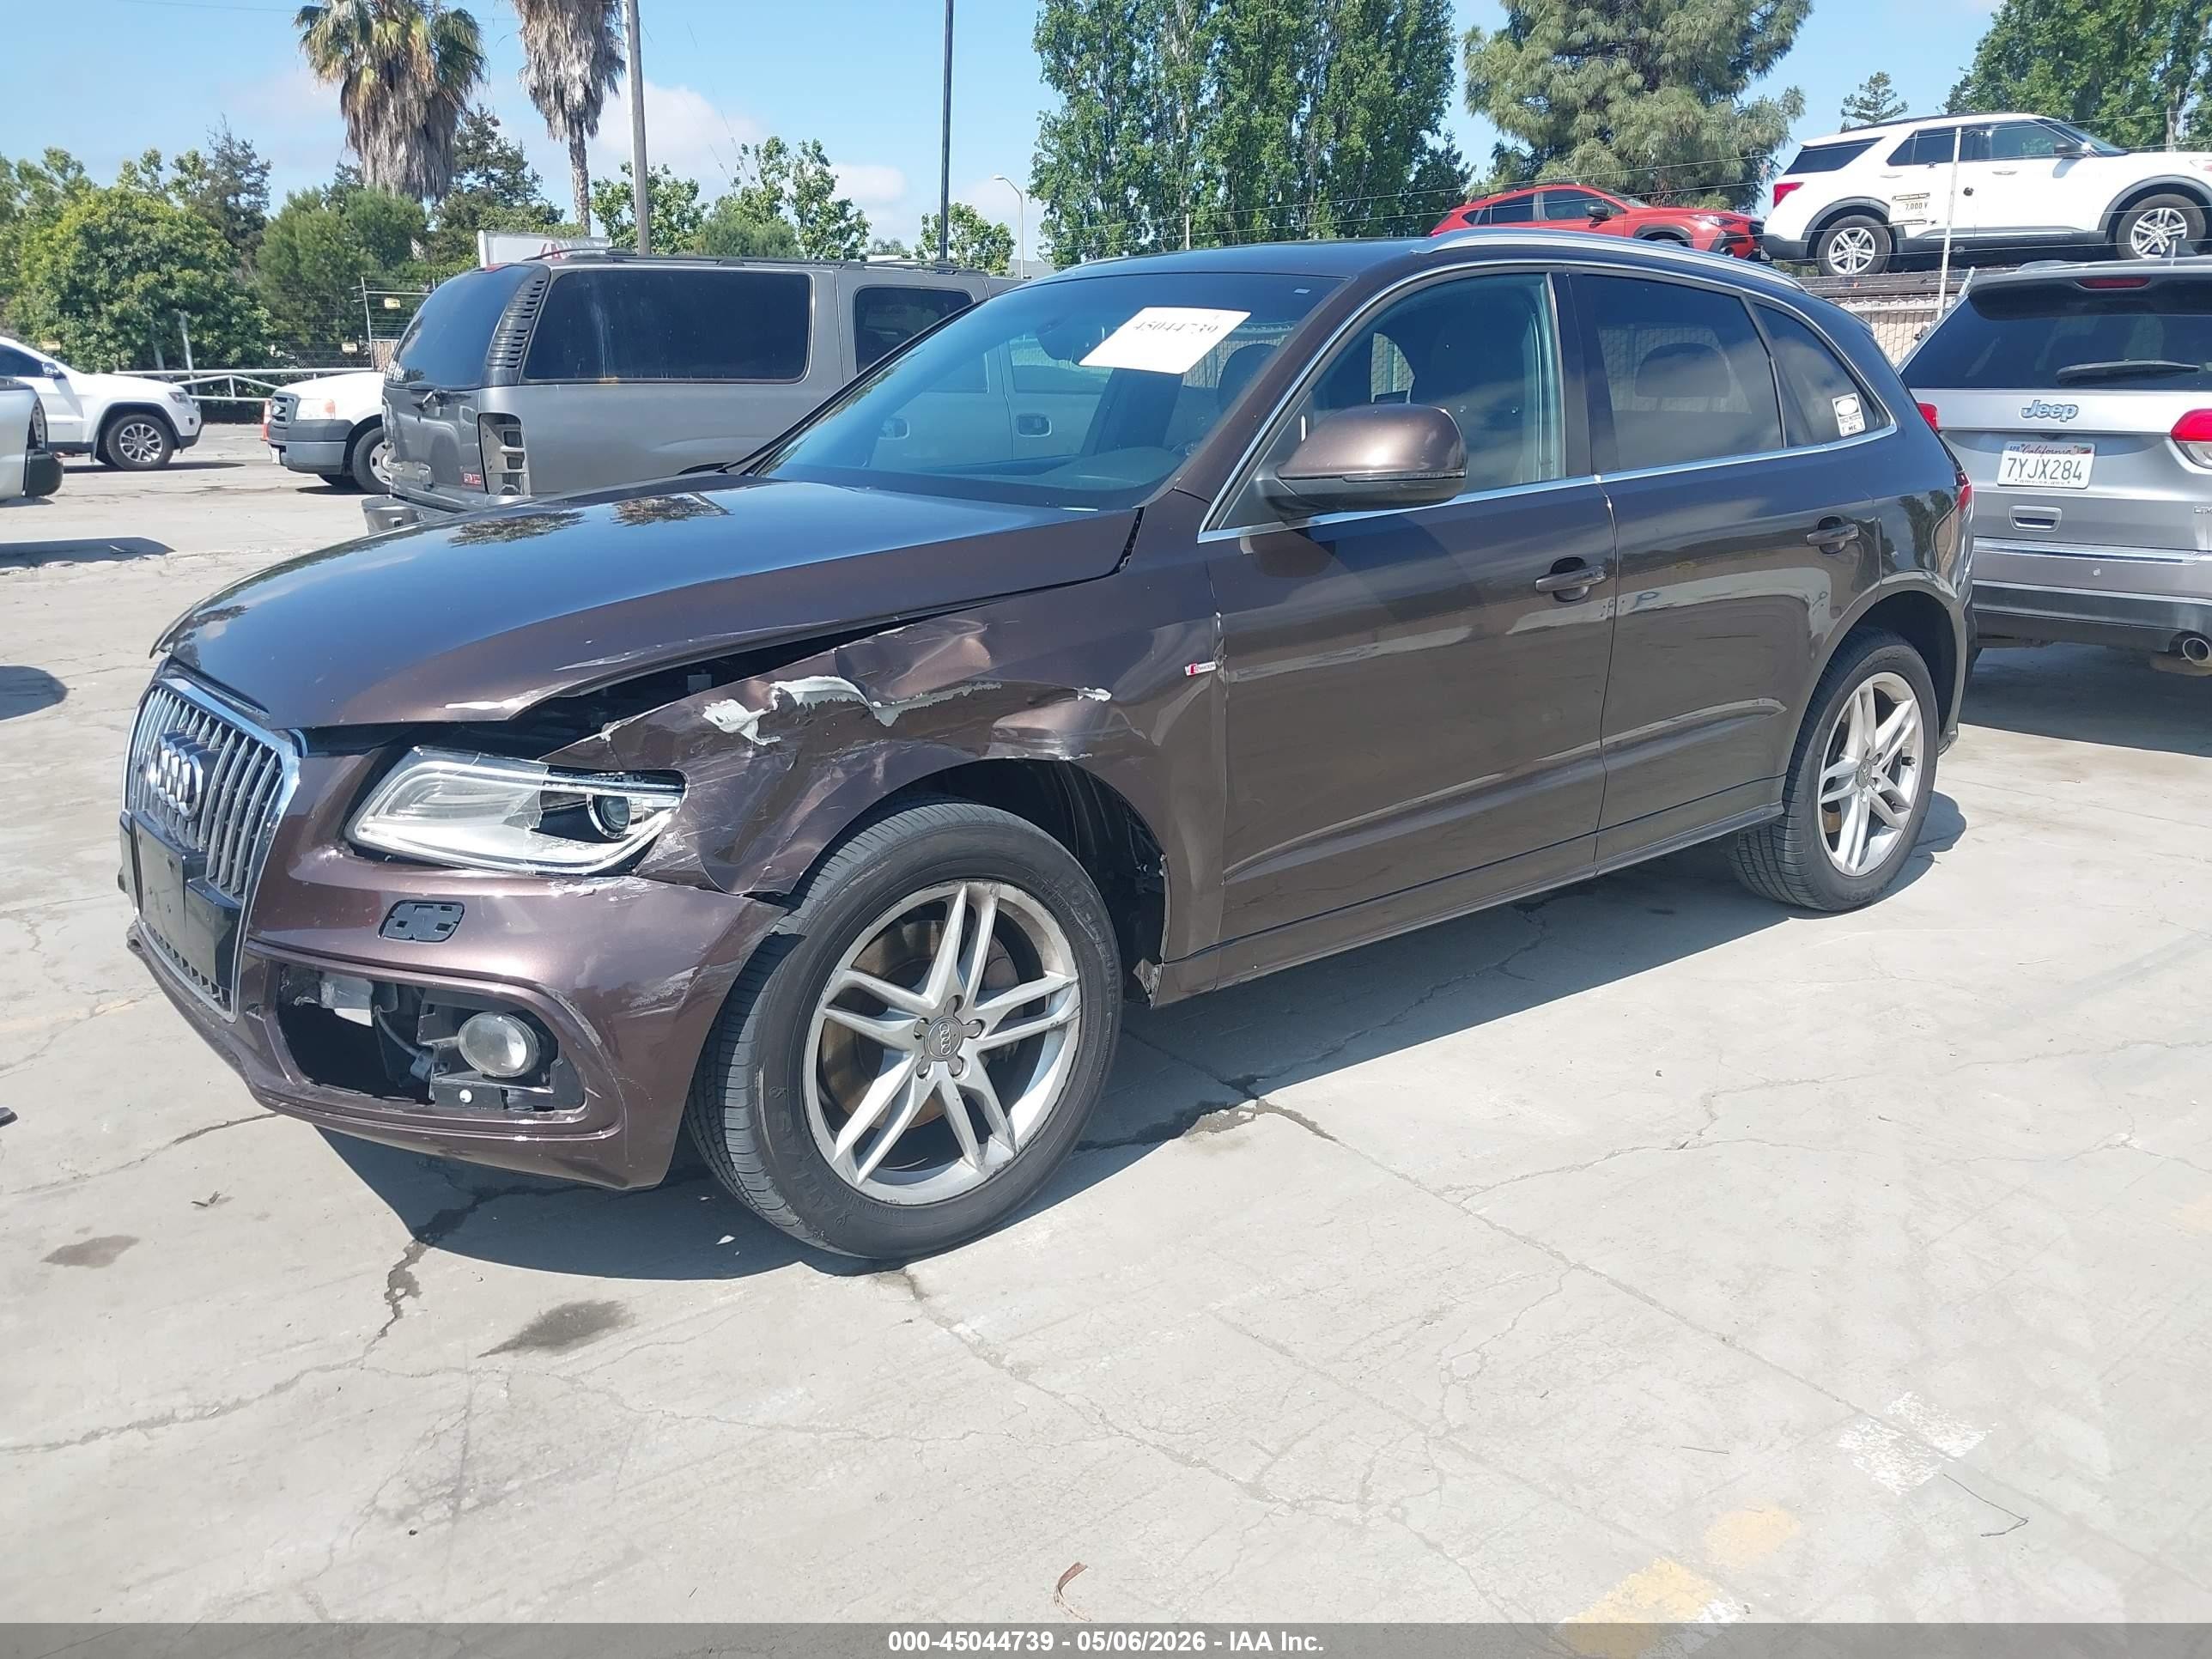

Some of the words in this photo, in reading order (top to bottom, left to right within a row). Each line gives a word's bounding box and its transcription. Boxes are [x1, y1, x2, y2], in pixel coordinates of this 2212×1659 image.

[2021, 399, 2079, 422] Jeep
[2022, 443, 2073, 458] California
[2007, 457, 2082, 481] 7YJX284
